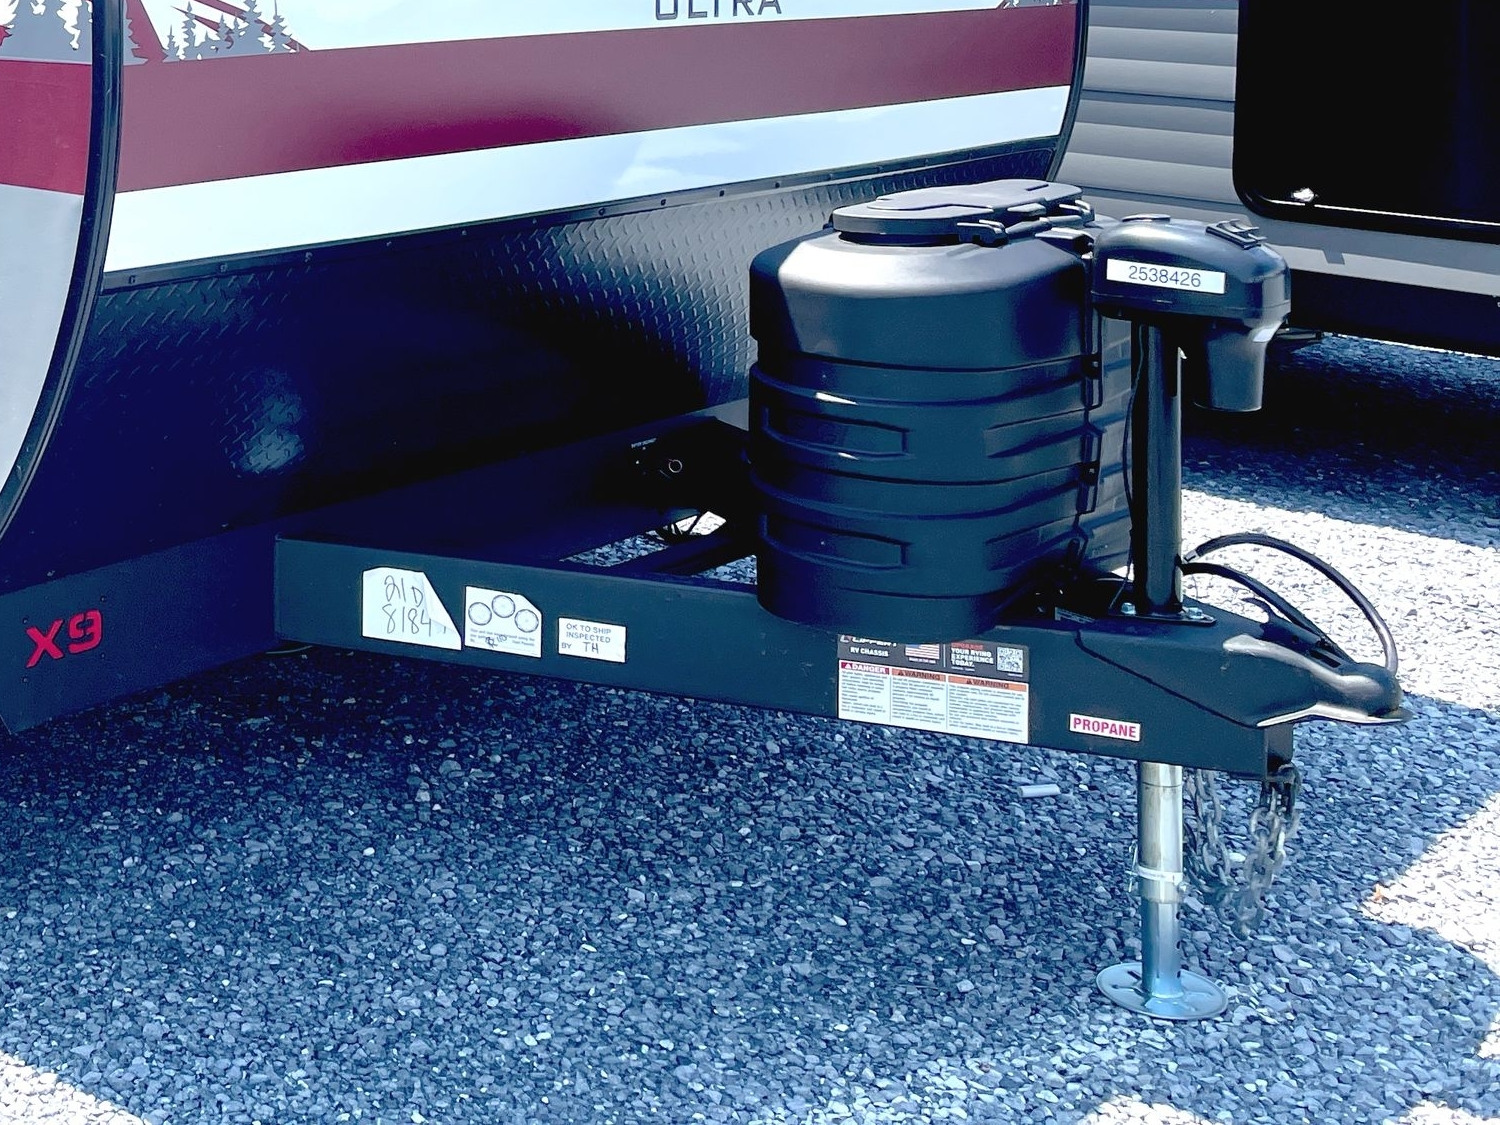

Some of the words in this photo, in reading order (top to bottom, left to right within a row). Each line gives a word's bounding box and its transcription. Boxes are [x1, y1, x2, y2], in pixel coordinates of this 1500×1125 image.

[1128, 265, 1201, 288] 2538426
[566, 623, 578, 631] OK
[580, 625, 591, 633] TO
[593, 626, 612, 635] SHIP
[26, 609, 102, 669] X9
[565, 631, 611, 644] INSPECTED
[561, 641, 572, 649] BY
[860, 648, 889, 657] CHASSIS
[951, 648, 970, 656] YOUR
[951, 654, 994, 664] EXPERIENCE
[852, 663, 886, 674] DANGER
[904, 669, 941, 681] WARNING
[972, 679, 1009, 689] WARNING
[1073, 717, 1137, 738] PROPANE
